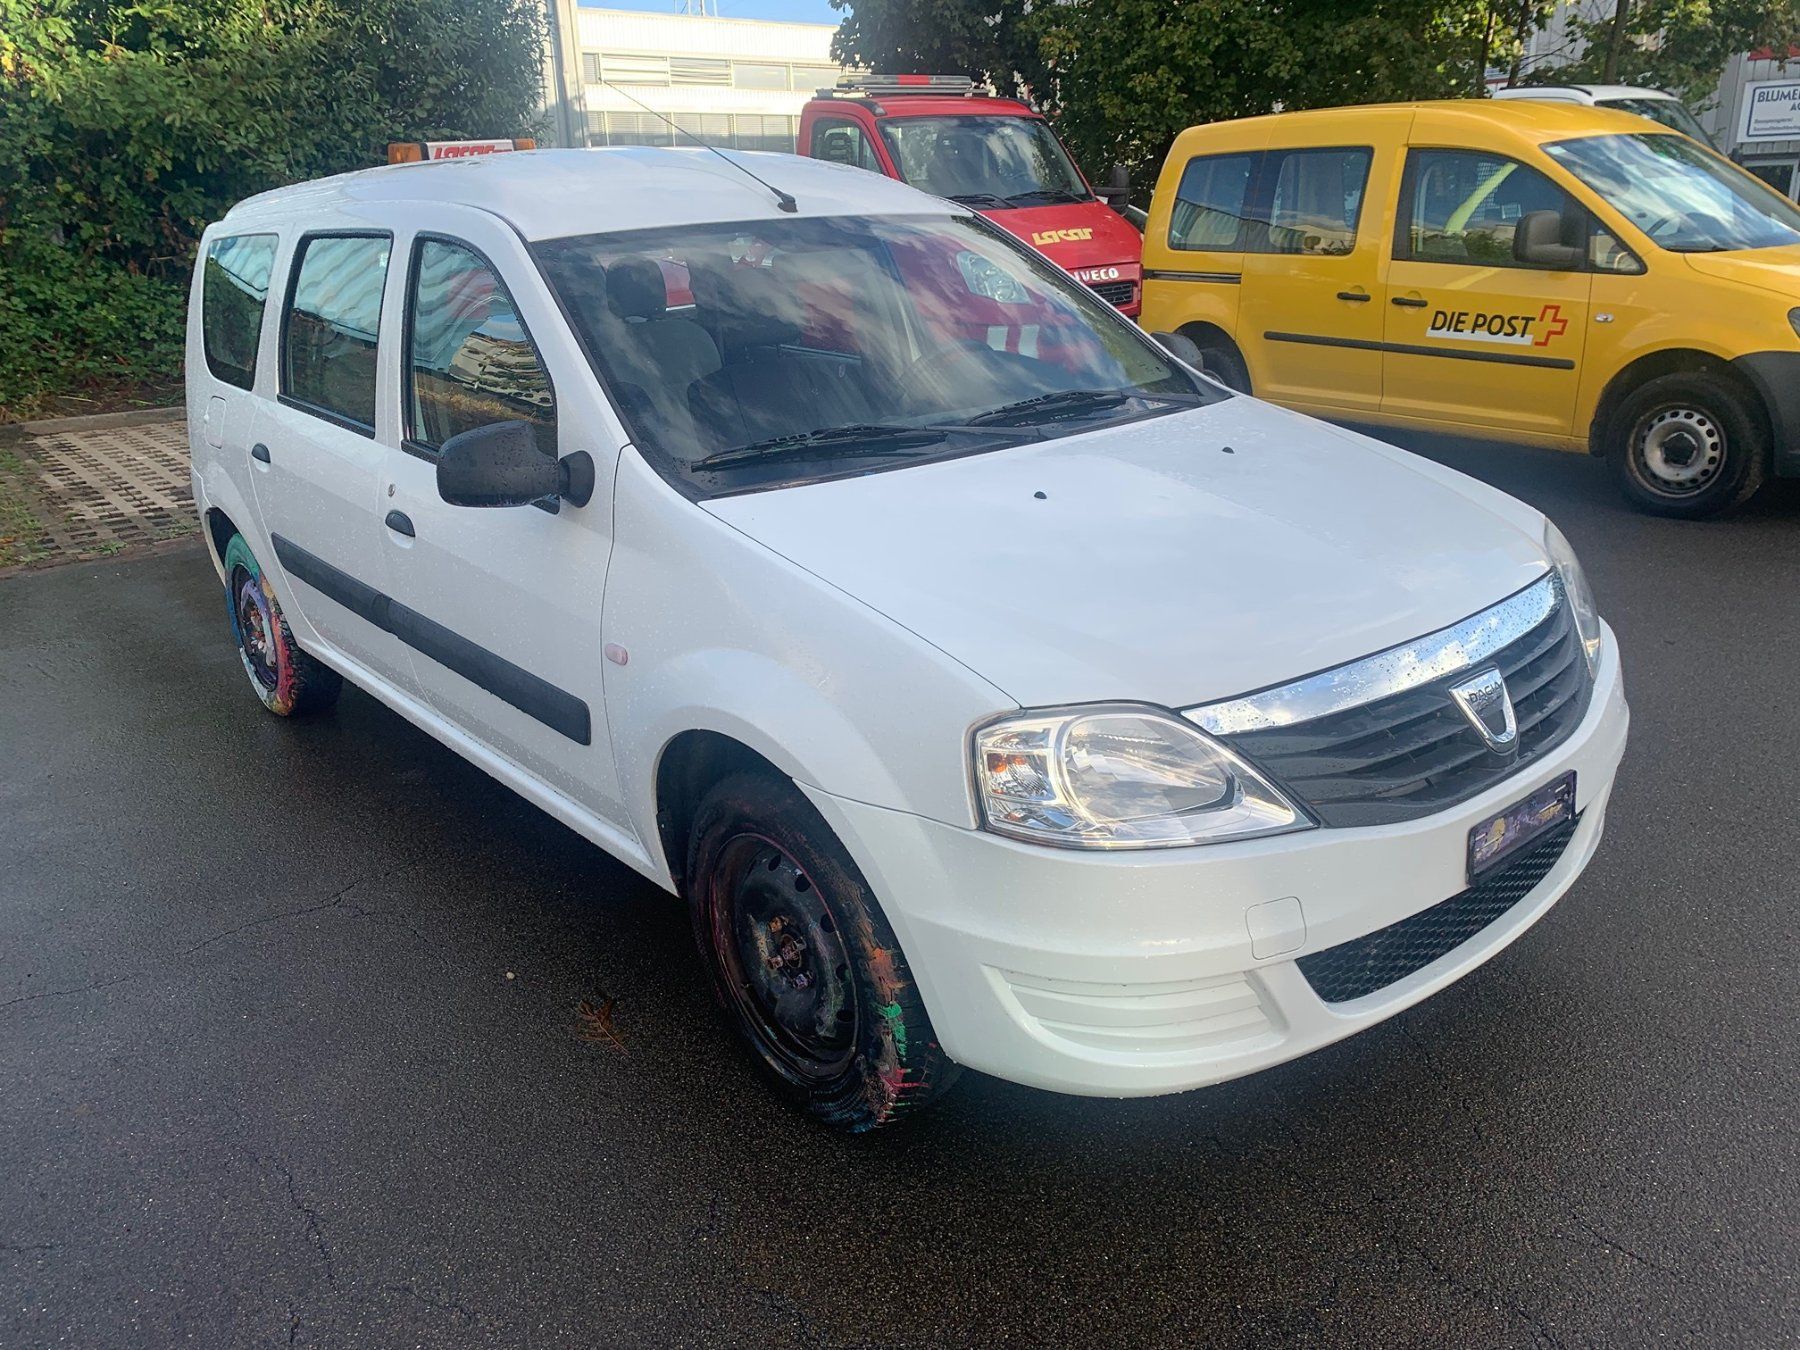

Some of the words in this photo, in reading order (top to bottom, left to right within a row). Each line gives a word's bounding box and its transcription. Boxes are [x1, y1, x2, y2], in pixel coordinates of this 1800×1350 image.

[1757, 88, 1800, 102] BLUME
[1073, 267, 1120, 282] IVECO
[1430, 310, 1469, 333] DIE
[1470, 313, 1536, 338] POST
[1468, 681, 1503, 703] DACIA
